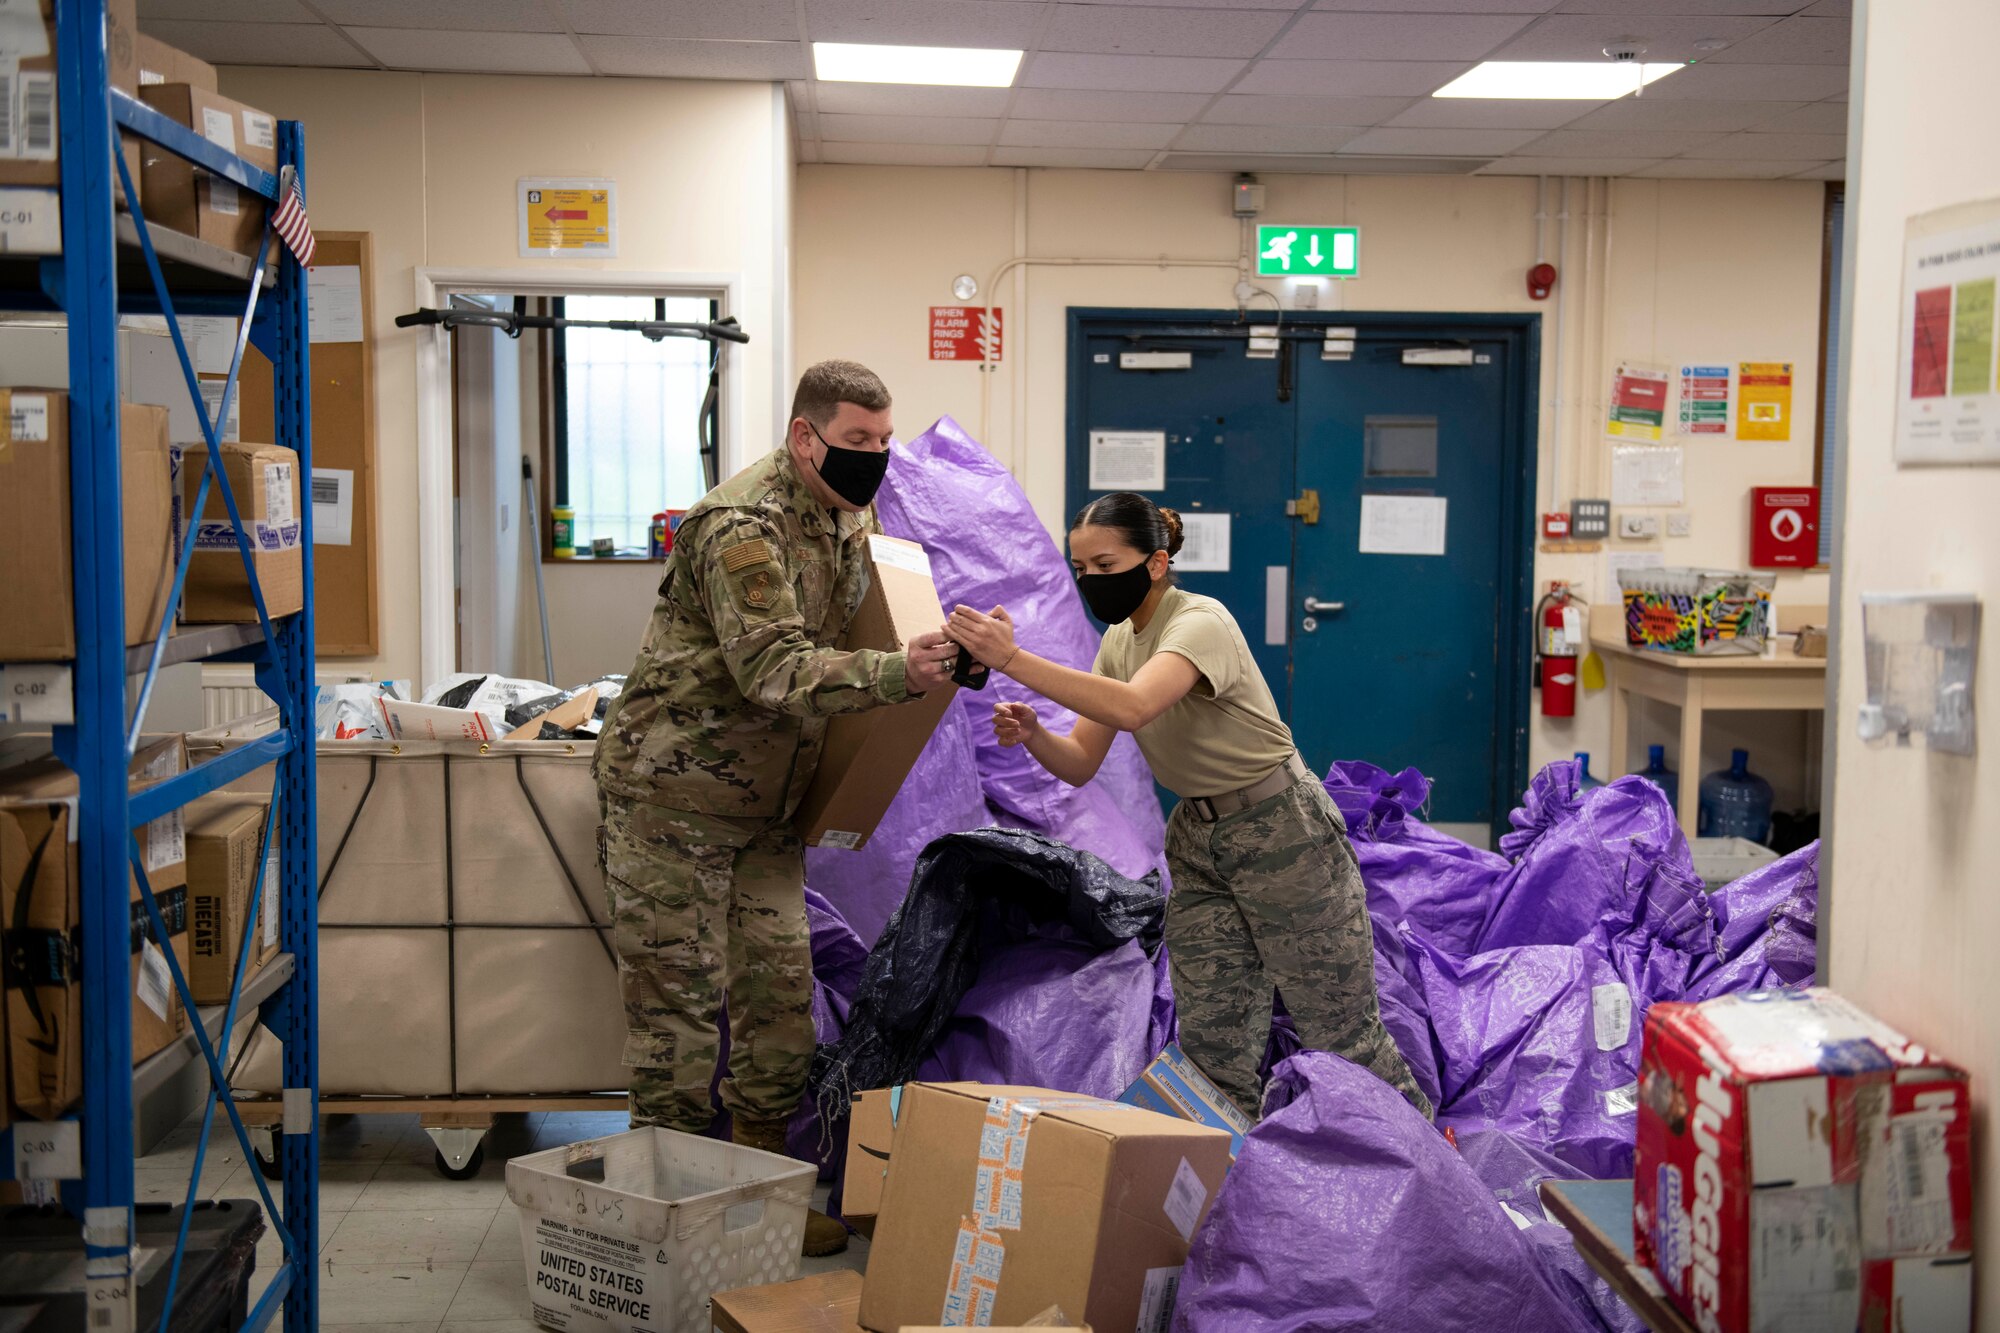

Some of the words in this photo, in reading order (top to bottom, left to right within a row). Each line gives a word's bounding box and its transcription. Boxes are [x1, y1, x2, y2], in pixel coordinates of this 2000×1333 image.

[1, 211, 33, 224] C-01
[14, 683, 47, 696] C-02
[195, 896, 212, 956] DIECAST
[22, 1142, 56, 1154] C-03
[975, 1169, 988, 1210] PLACE
[541, 1218, 567, 1232] WARNING
[572, 1227, 584, 1237] NOT
[586, 1231, 598, 1241] FOR
[600, 1235, 624, 1248] PRIVATE
[626, 1242, 639, 1253] USE
[552, 1234, 566, 1242] PENALTY
[611, 1251, 624, 1259] POSTAL
[625, 1255, 645, 1265] PROPERTY
[540, 1249, 585, 1278] UNITED
[589, 1264, 643, 1296] STATES
[536, 1270, 584, 1301] POSTAL
[588, 1288, 649, 1321] SERVICE
[570, 1303, 580, 1312] FOR
[581, 1306, 593, 1316] MAIL
[594, 1311, 608, 1321] ONLY
